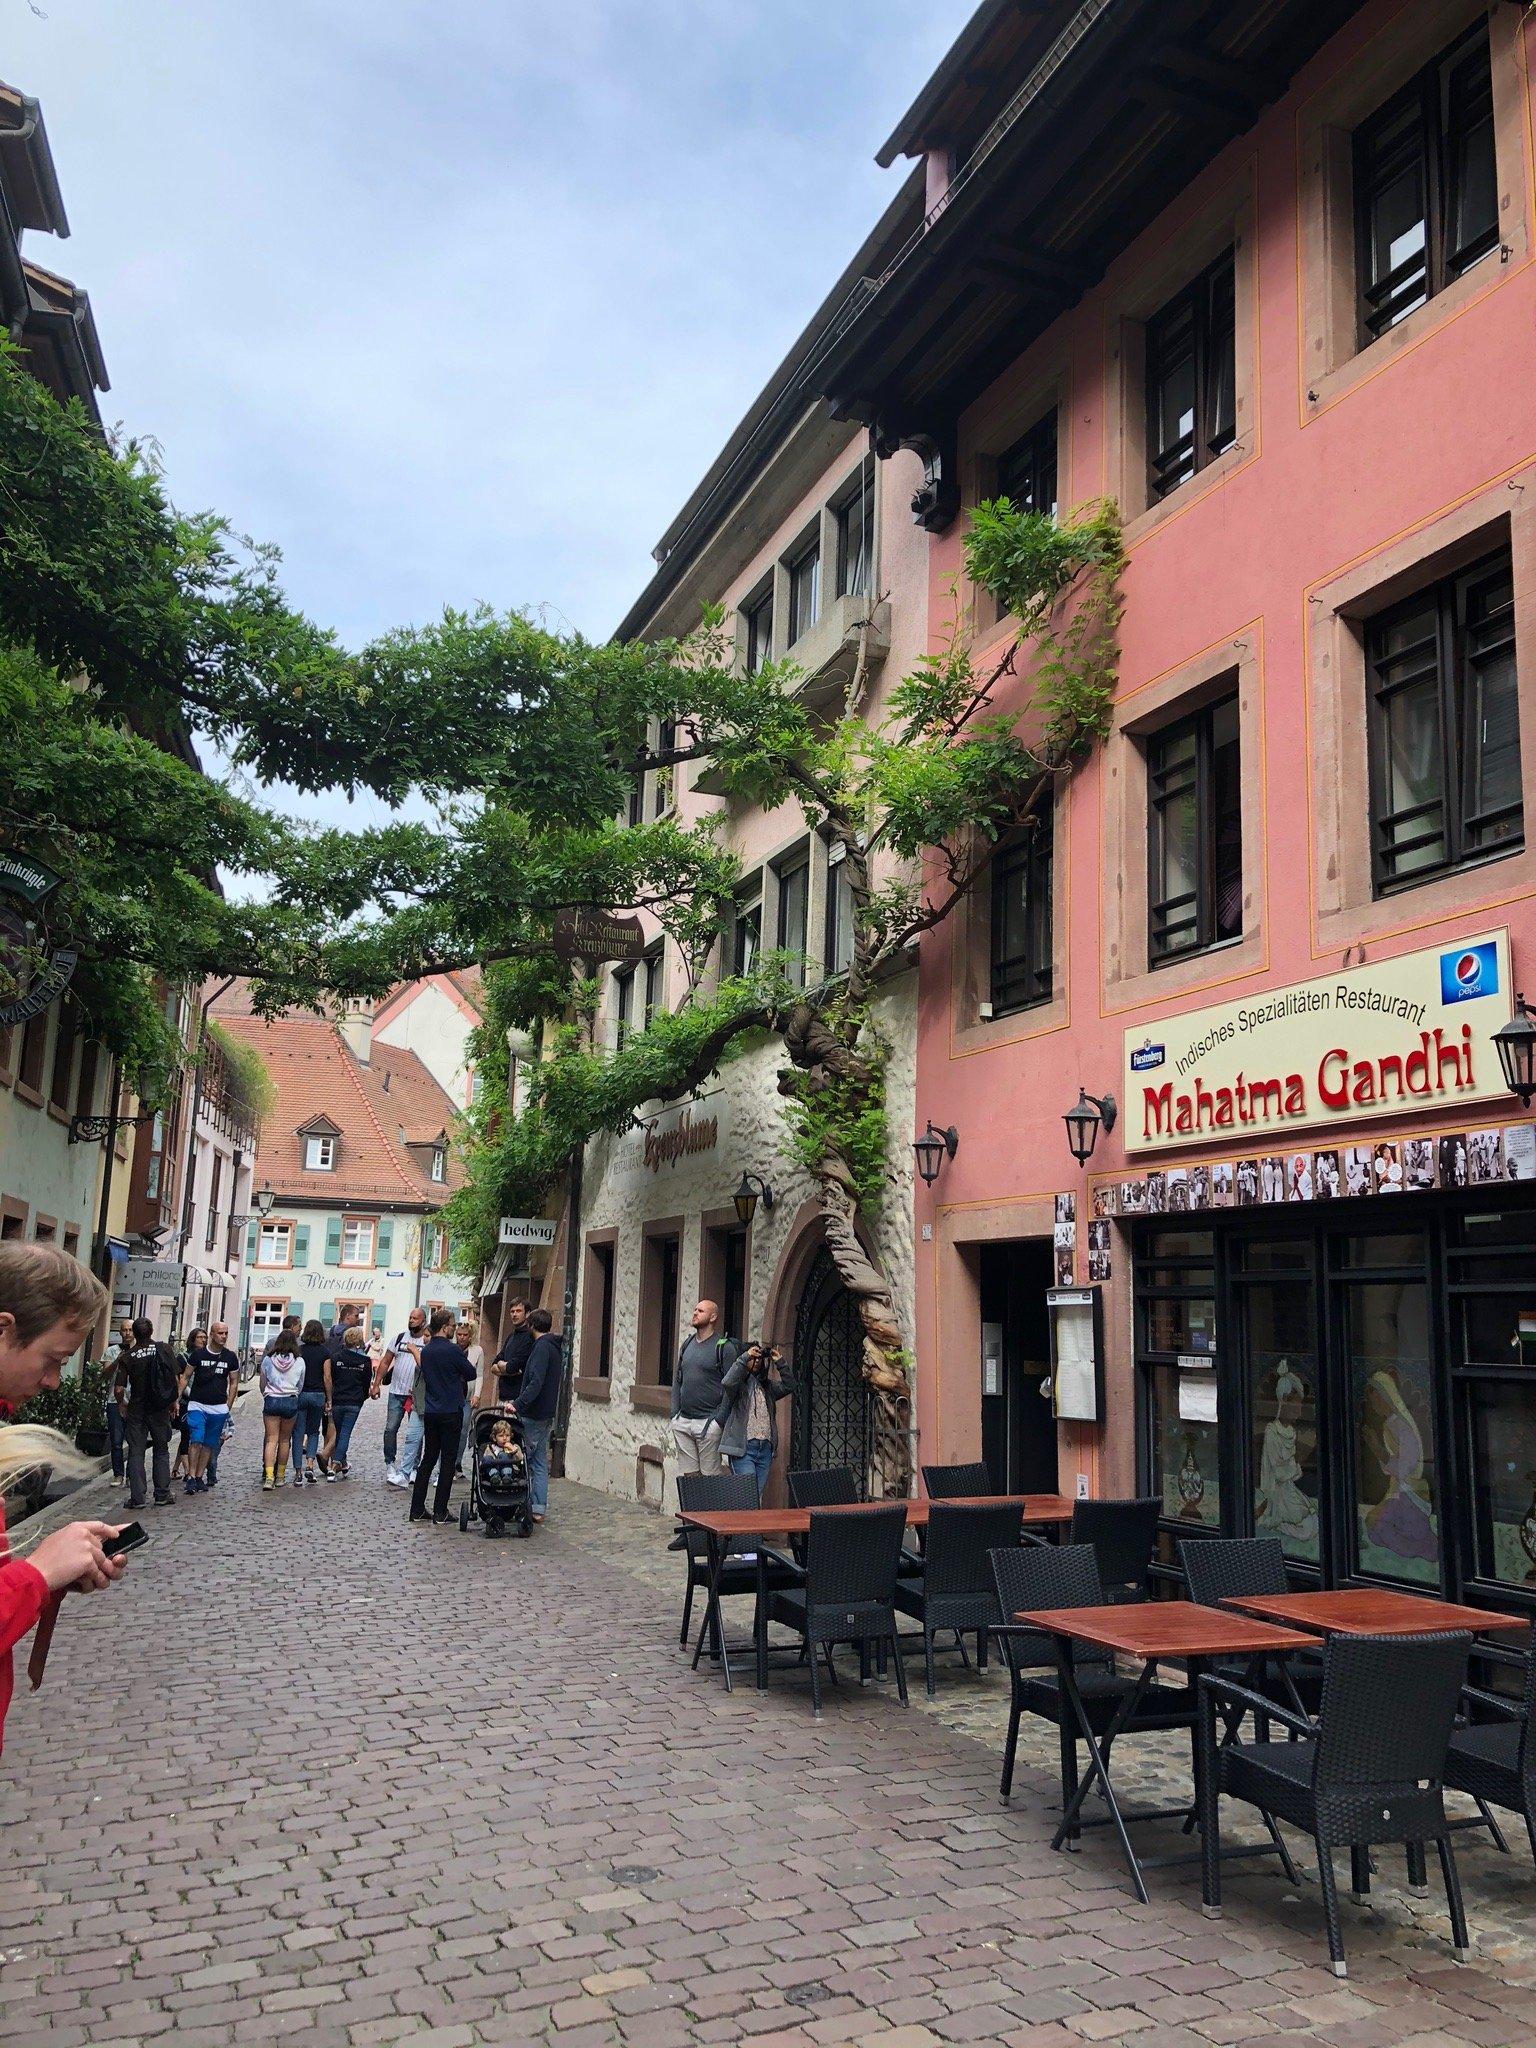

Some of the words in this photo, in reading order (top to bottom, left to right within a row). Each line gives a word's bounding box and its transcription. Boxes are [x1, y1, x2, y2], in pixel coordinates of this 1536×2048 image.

[1458, 984, 1481, 998] pepsi
[1175, 1022, 1235, 1076] Indisches
[1238, 991, 1330, 1033] Spezialitäten
[1336, 985, 1426, 1026] Restaurant
[1134, 1051, 1162, 1067] Fürstenberg
[1142, 1072, 1307, 1137] Mahatma
[1318, 1023, 1475, 1108] Gandhi
[298, 1272, 374, 1293] Wirtschaft
